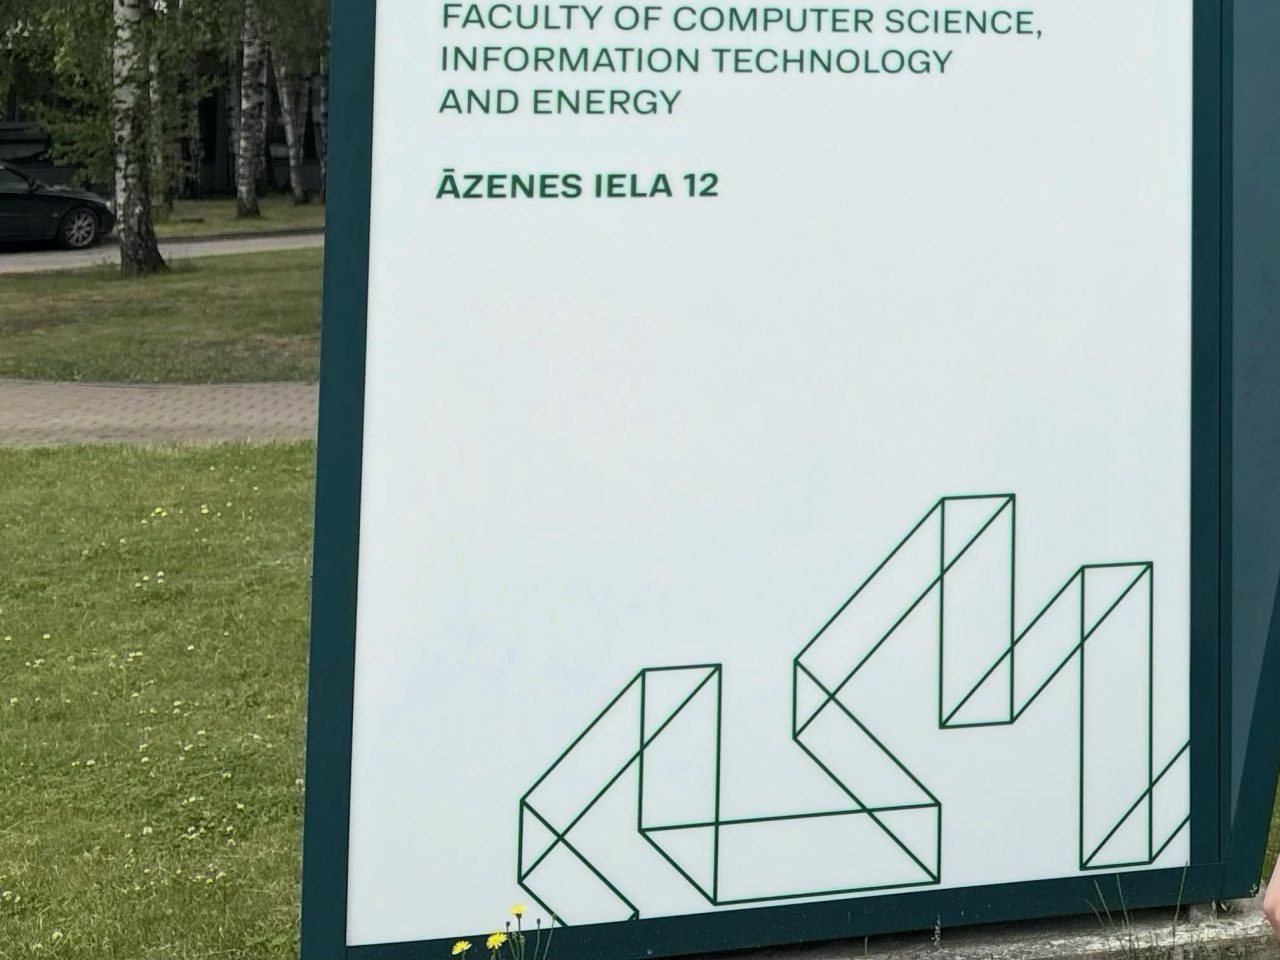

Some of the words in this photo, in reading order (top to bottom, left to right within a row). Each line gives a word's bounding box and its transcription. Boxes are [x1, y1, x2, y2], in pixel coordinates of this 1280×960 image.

[442, 3, 604, 31] FACULTY
[613, 5, 664, 32] OF
[672, 6, 875, 34] COMPUTER
[884, 9, 1043, 41] SCIENCE,
[441, 46, 700, 74] INFORMATION
[710, 48, 954, 75] TECHNOLOGY
[437, 89, 520, 115] AND
[532, 89, 683, 116] ENERGY
[434, 168, 583, 200] ĀZENES
[594, 173, 674, 199] IELA
[682, 172, 719, 198] 12
